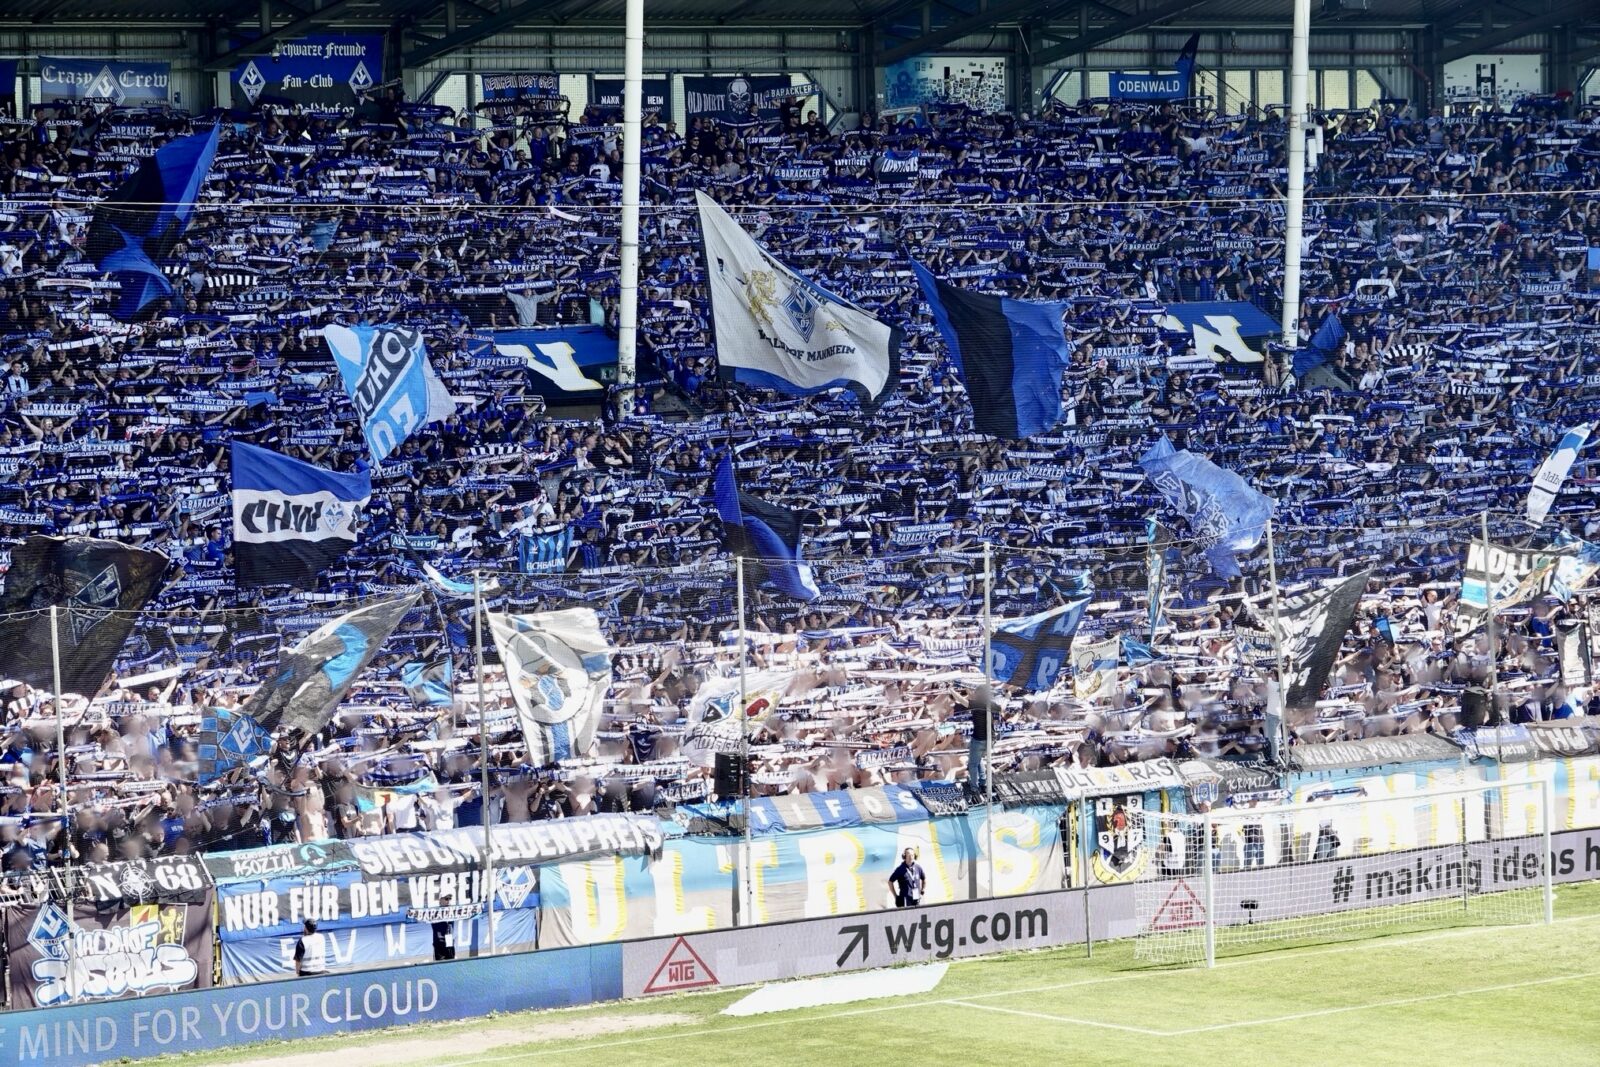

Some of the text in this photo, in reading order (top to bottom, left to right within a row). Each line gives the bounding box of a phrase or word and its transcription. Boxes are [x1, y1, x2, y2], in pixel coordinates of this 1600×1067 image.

[323, 42, 366, 59] Freunde
[41, 65, 168, 89] Crazy Crew
[309, 73, 333, 88] Club
[1118, 80, 1180, 93] ODENWALD
[687, 91, 725, 113] OLD DIRTY
[1237, 153, 1264, 163] BARACKLER
[781, 167, 820, 178] BARACKLER
[1213, 186, 1245, 196] BARACKLER
[1526, 283, 1561, 293] BARACKLER
[806, 344, 857, 362] MANNHEIM
[29, 476, 59, 487] WALDHOF
[187, 494, 228, 509] BARACKLER
[1059, 769, 1096, 790] ULT
[1130, 760, 1175, 780] RAS
[752, 789, 920, 826] TIFOS
[352, 839, 429, 874] SIEG
[480, 818, 581, 859] JEDEN
[579, 814, 664, 852] PREIS
[155, 862, 201, 891] 68
[561, 812, 1042, 946] ULTRAS
[1366, 852, 1482, 901] making
[225, 868, 497, 932] NUR FÜR DEN VEREIN
[415, 904, 472, 921] BARACKLER
[885, 907, 1048, 960] wtg.com
[668, 959, 695, 983] WTG
[19, 979, 439, 1061] MIND FOR YOUR CLOUD
